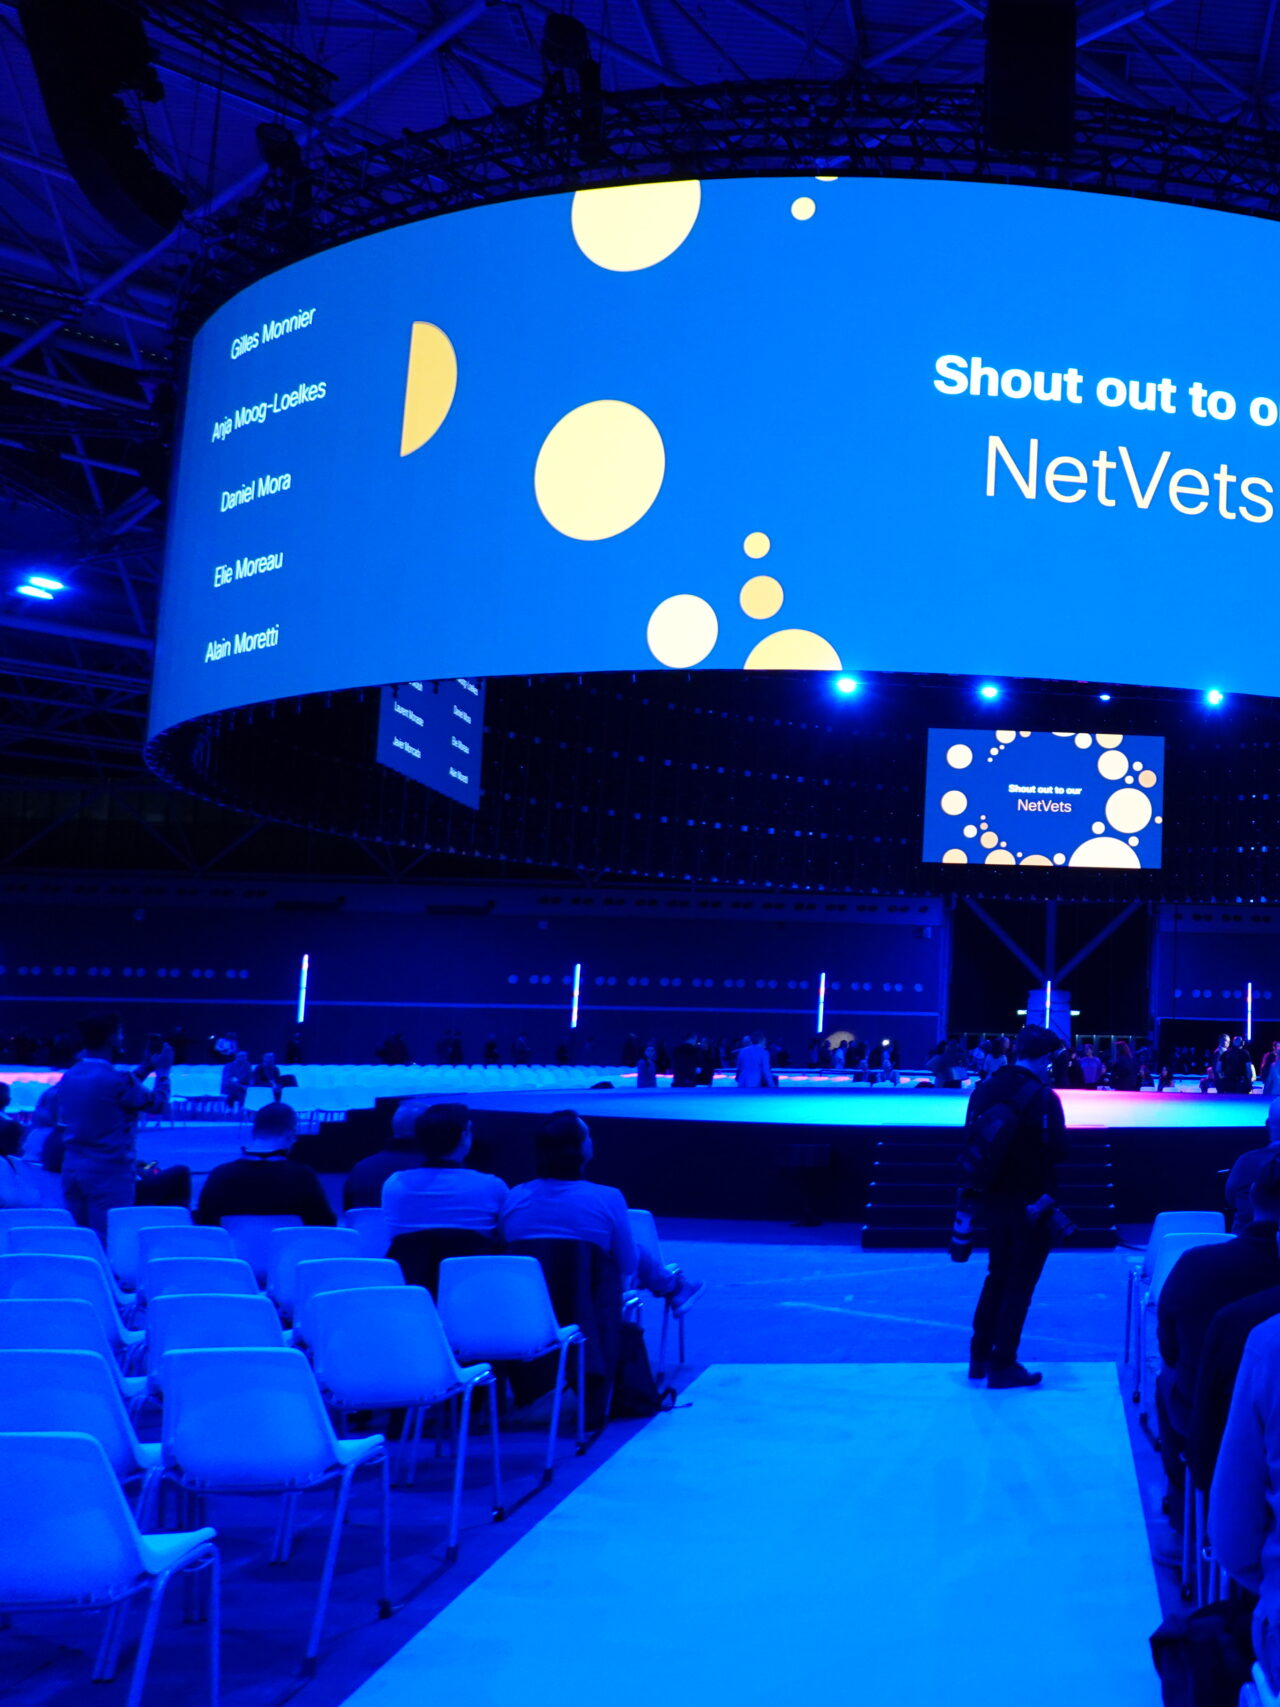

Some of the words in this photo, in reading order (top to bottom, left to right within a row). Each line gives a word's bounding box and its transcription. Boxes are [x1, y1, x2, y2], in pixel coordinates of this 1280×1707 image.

[231, 332, 259, 359] Gilles
[262, 308, 316, 343] Monnier
[934, 355, 1083, 404] Shout
[1096, 377, 1176, 413] out
[1189, 382, 1236, 420] to
[212, 416, 232, 442] Anja
[234, 382, 326, 429] Moog-Loelkes
[221, 480, 255, 512] Daniel
[257, 473, 291, 497] Mora
[987, 436, 1273, 523] NetVets
[214, 565, 233, 587] Elie
[235, 552, 283, 579] Moreau
[205, 638, 231, 663] Alain
[234, 624, 279, 654] Moretti
[1007, 783, 1036, 794] Shout
[1037, 785, 1053, 795] out
[1054, 785, 1065, 795] to
[1066, 787, 1083, 795] our
[1017, 798, 1072, 813] NetVets
